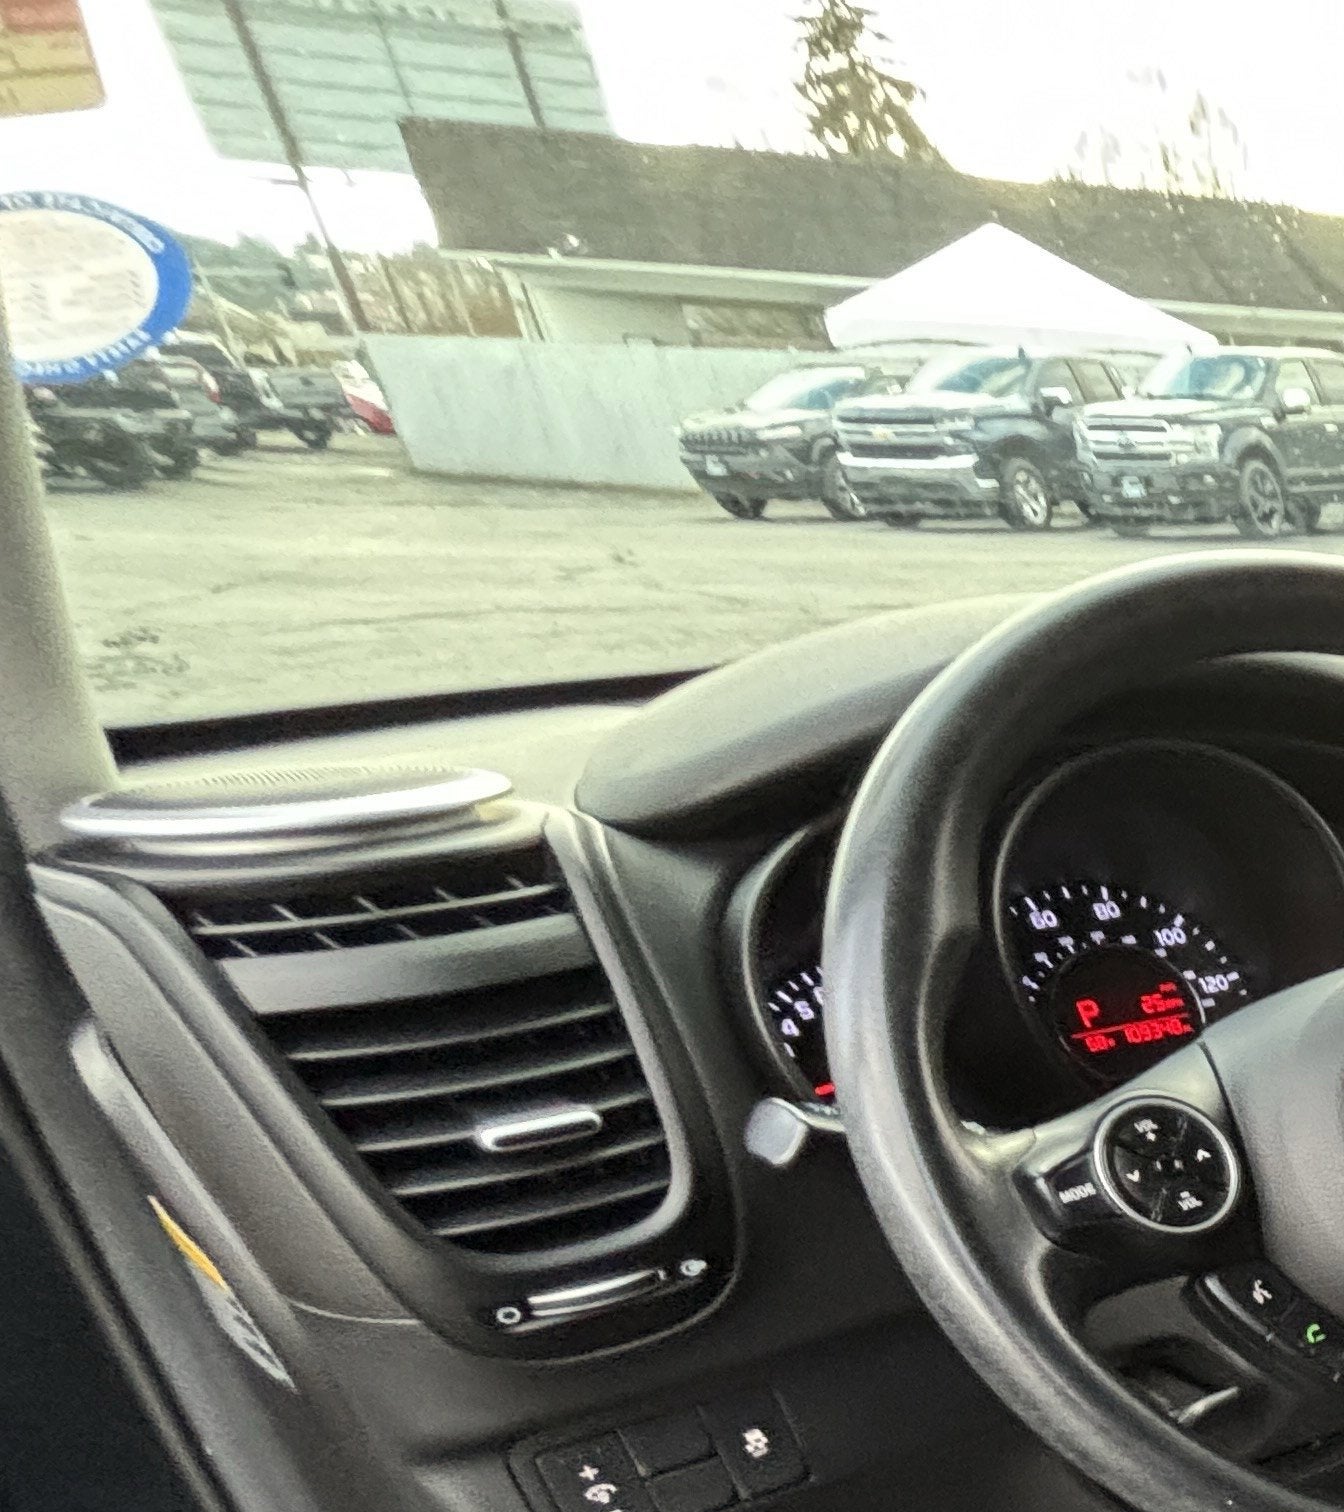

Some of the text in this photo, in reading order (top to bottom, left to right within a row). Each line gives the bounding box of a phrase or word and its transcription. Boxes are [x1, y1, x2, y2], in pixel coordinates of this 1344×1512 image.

[1092, 899, 1121, 922] 80
[1154, 926, 1187, 948] 100
[1200, 973, 1229, 994] 120
[1075, 999, 1100, 1028] P
